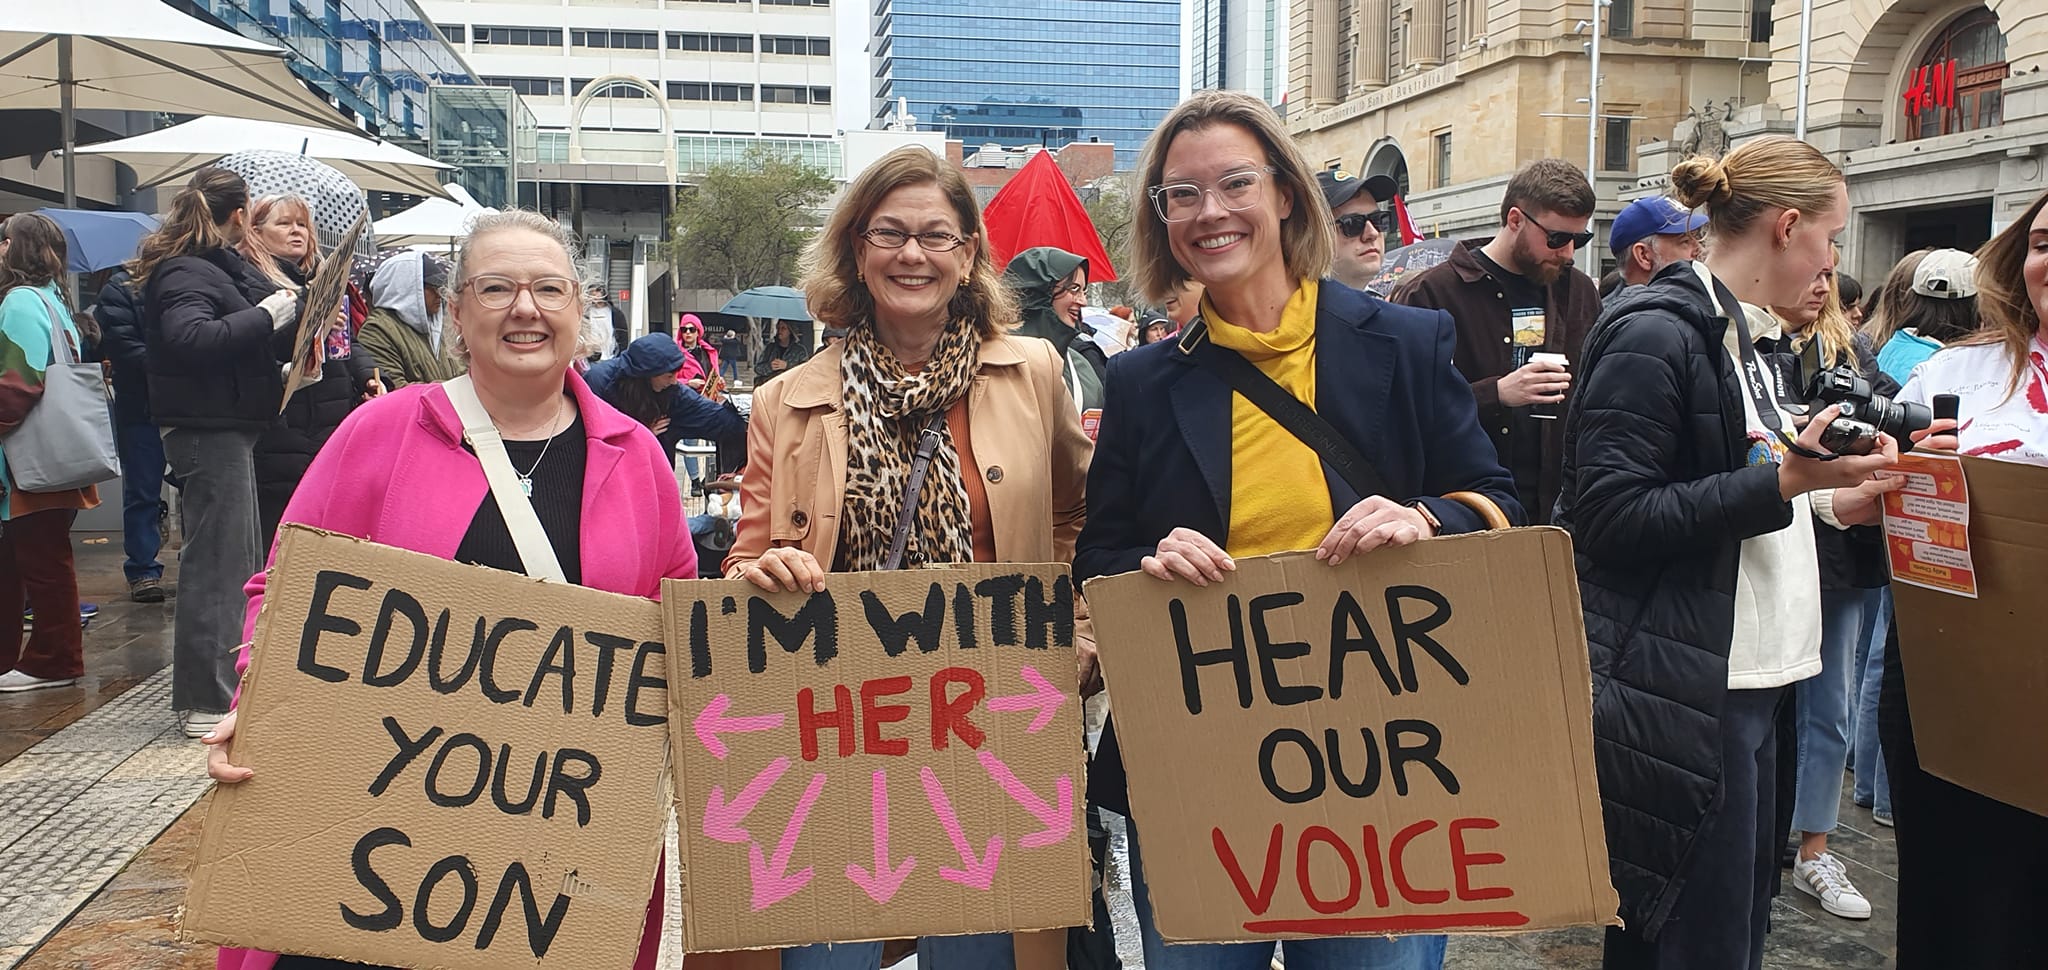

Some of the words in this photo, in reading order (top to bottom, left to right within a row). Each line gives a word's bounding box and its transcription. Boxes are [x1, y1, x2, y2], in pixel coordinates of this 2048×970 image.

[1367, 93, 1384, 108] Bank
[1903, 58, 1957, 117] H&M
[297, 569, 667, 727] EDUCATE
[690, 588, 839, 679] I'M
[859, 573, 1074, 658] WITH
[1169, 584, 1470, 715] HEAR
[796, 666, 987, 762] HER
[1258, 719, 1460, 804] OUR
[368, 716, 602, 828] YOUR
[339, 827, 571, 960] SON
[1211, 817, 1515, 916] VOICE
